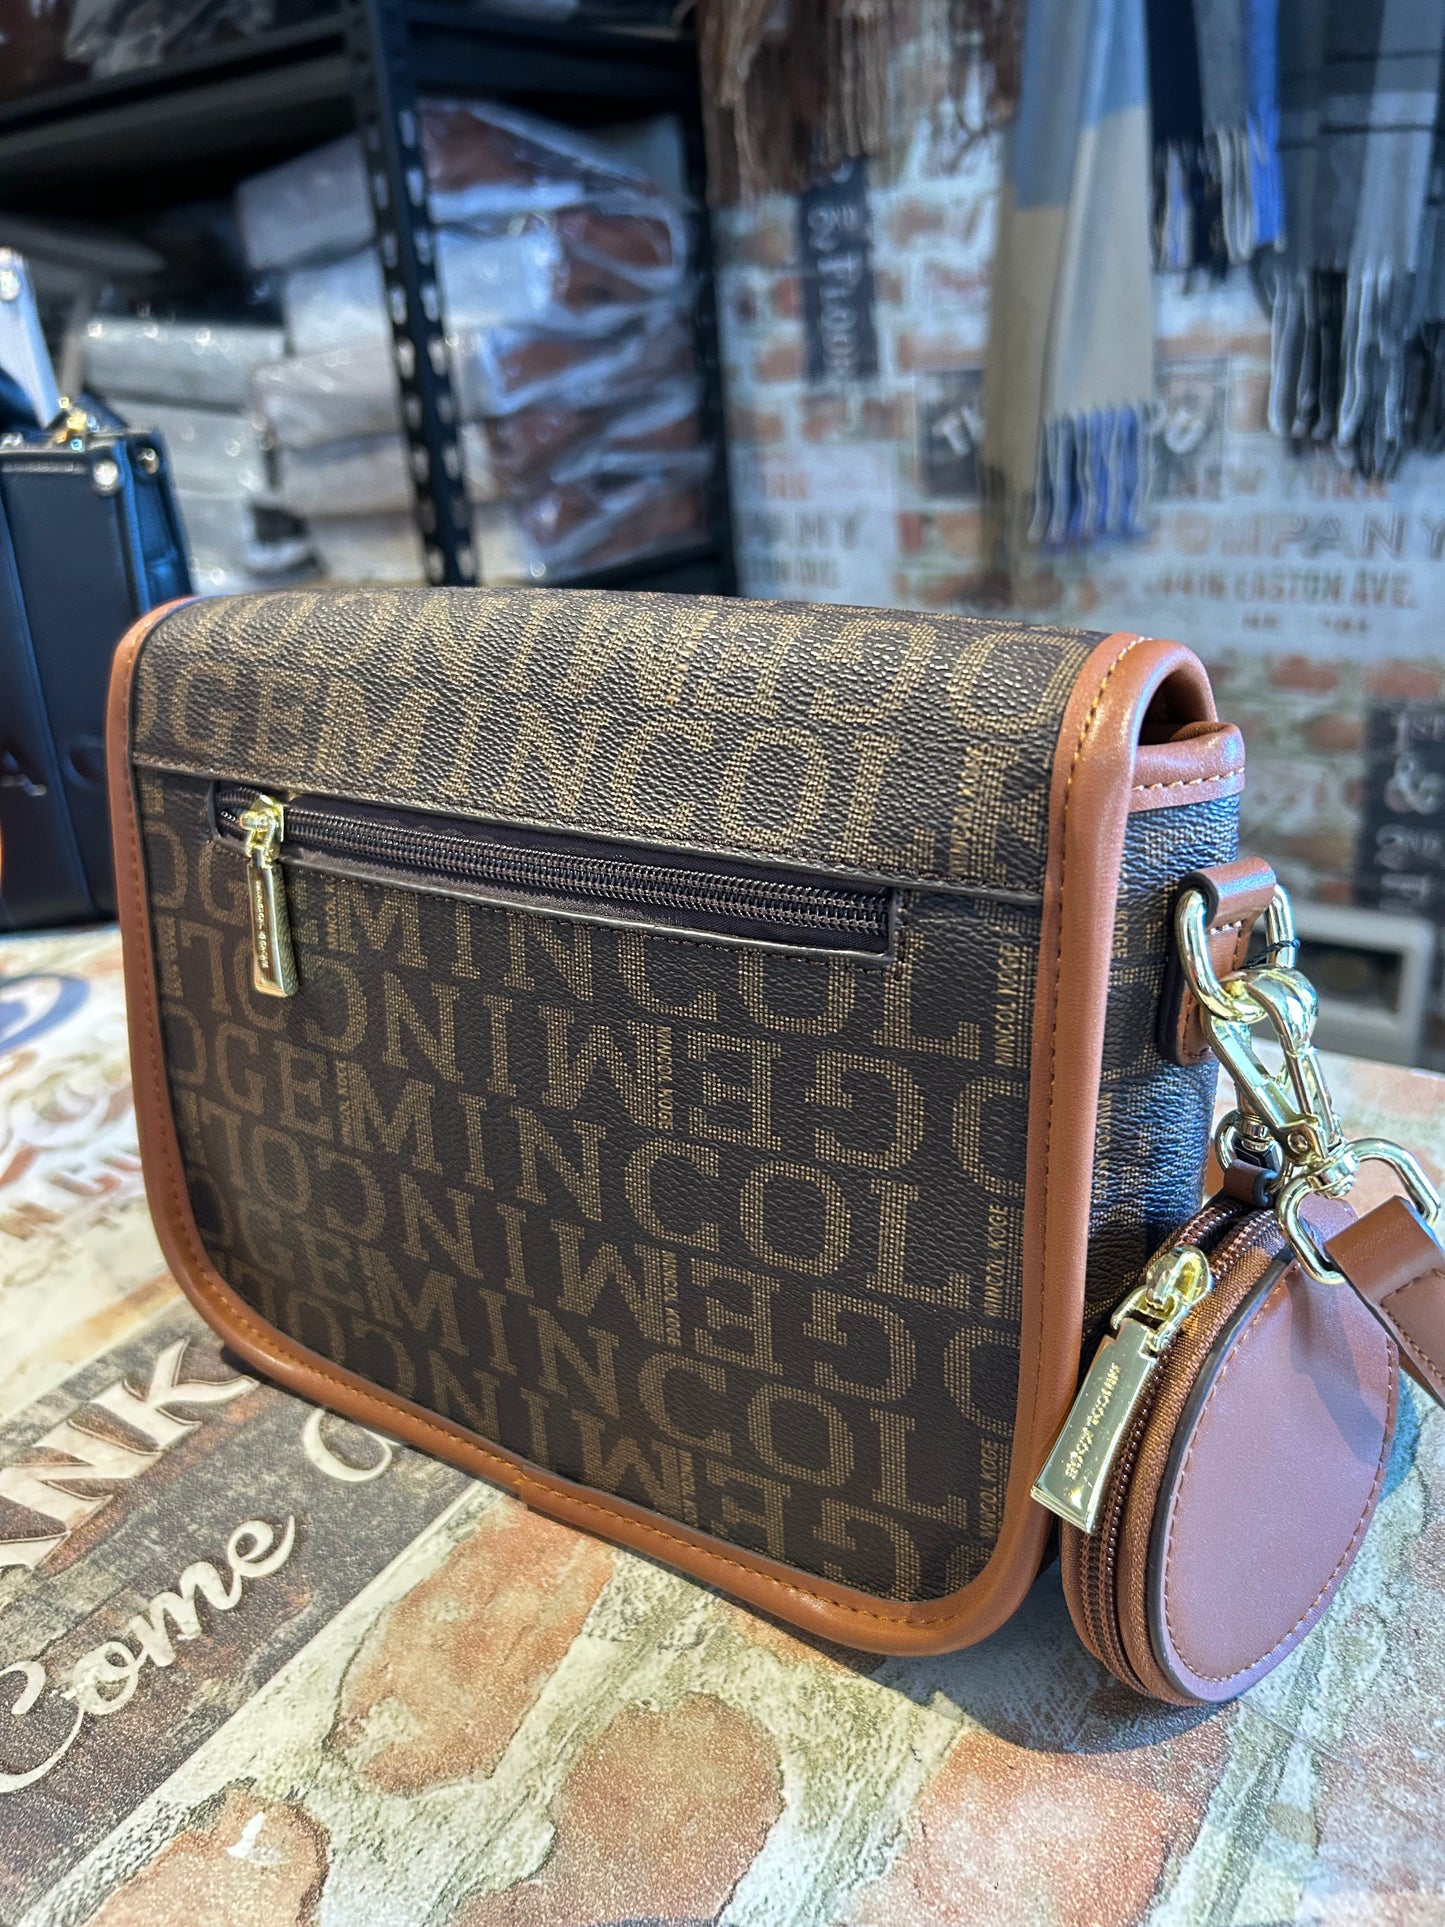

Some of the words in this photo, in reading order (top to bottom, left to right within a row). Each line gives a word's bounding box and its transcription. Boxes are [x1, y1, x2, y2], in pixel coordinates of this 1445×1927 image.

[997, 943, 1021, 995] KOGE
[656, 1024, 672, 1083] MINCOL
[994, 1005, 1017, 1067] MINCOL
[657, 1089, 674, 1131] KOGE
[987, 1204, 1009, 1250] KOGE
[661, 1249, 679, 1303] MINCOL
[984, 1257, 1004, 1318] MINCOL
[665, 1307, 682, 1347] KOGE
[980, 1438, 999, 1482] KOGE
[979, 1486, 998, 1539] MINCOL
